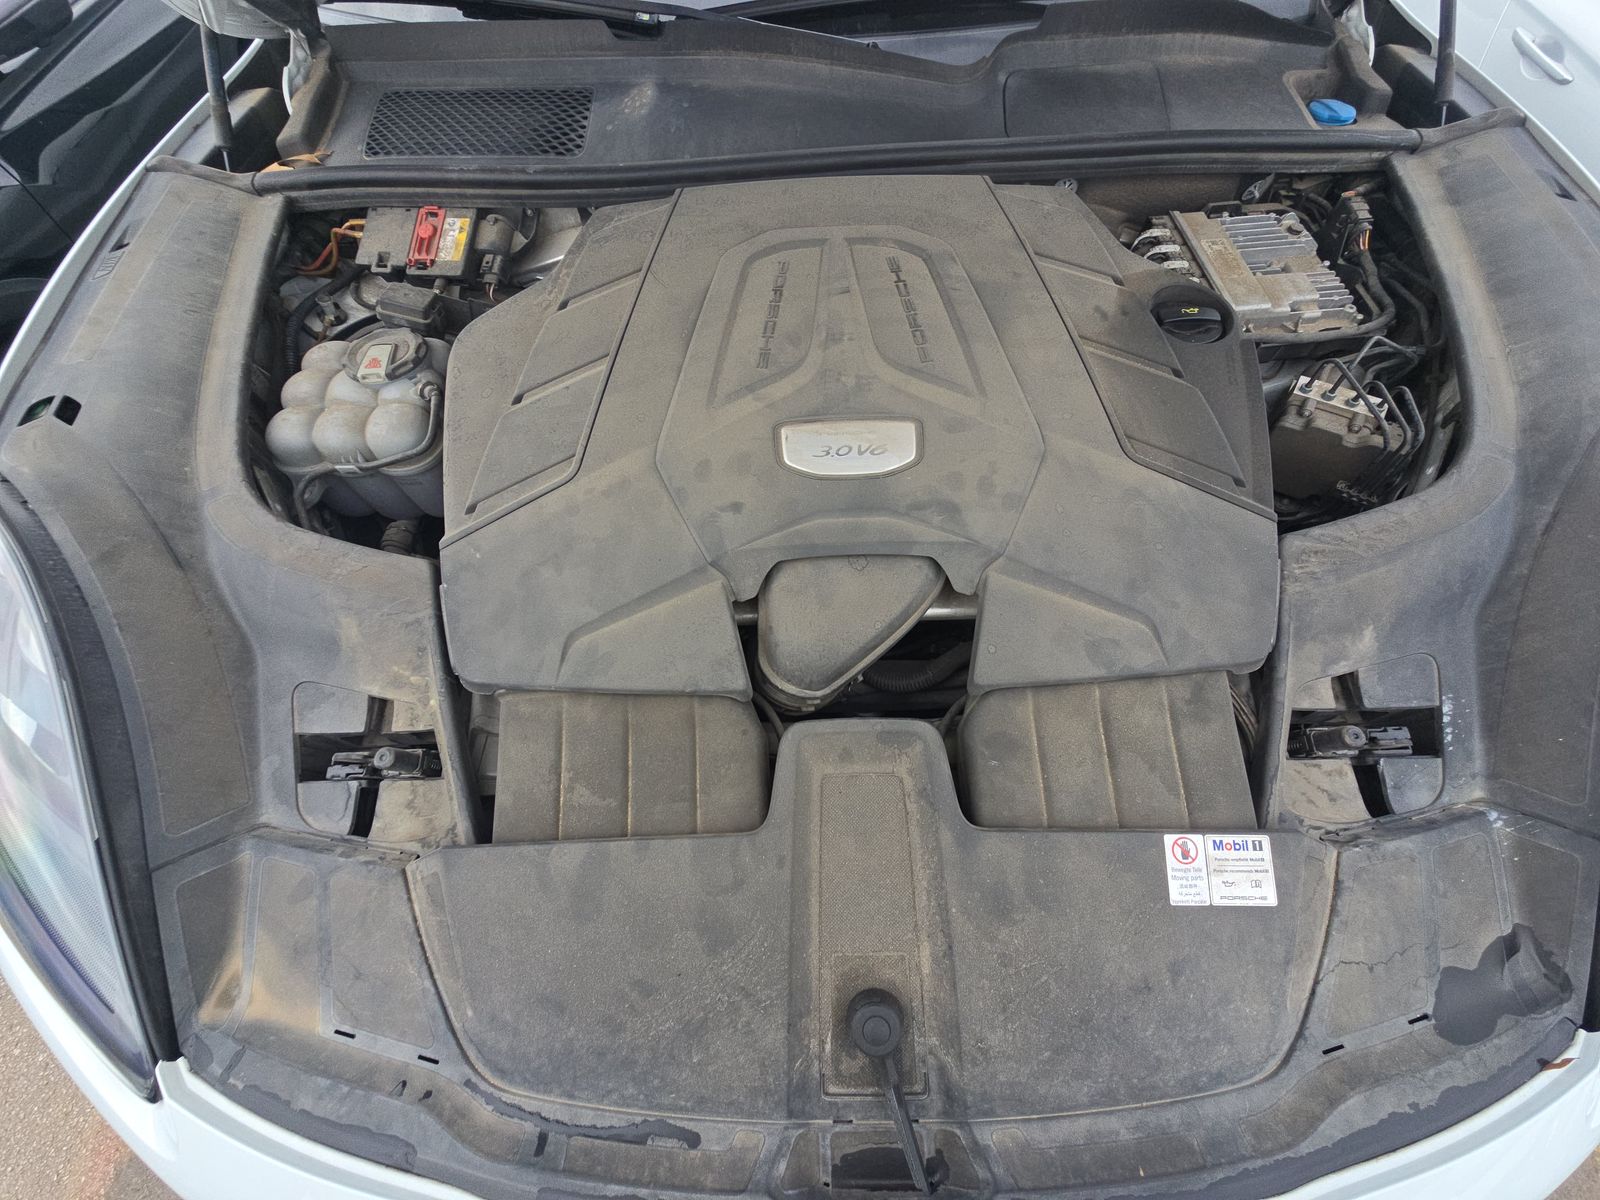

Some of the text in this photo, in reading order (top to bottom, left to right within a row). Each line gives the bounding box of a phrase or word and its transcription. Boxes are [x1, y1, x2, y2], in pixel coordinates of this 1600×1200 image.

[756, 261, 790, 369] PORSCHE
[886, 255, 934, 364] PORSCHE
[812, 444, 888, 458] 3.0 V6
[1212, 839, 1263, 851] Mobil 1
